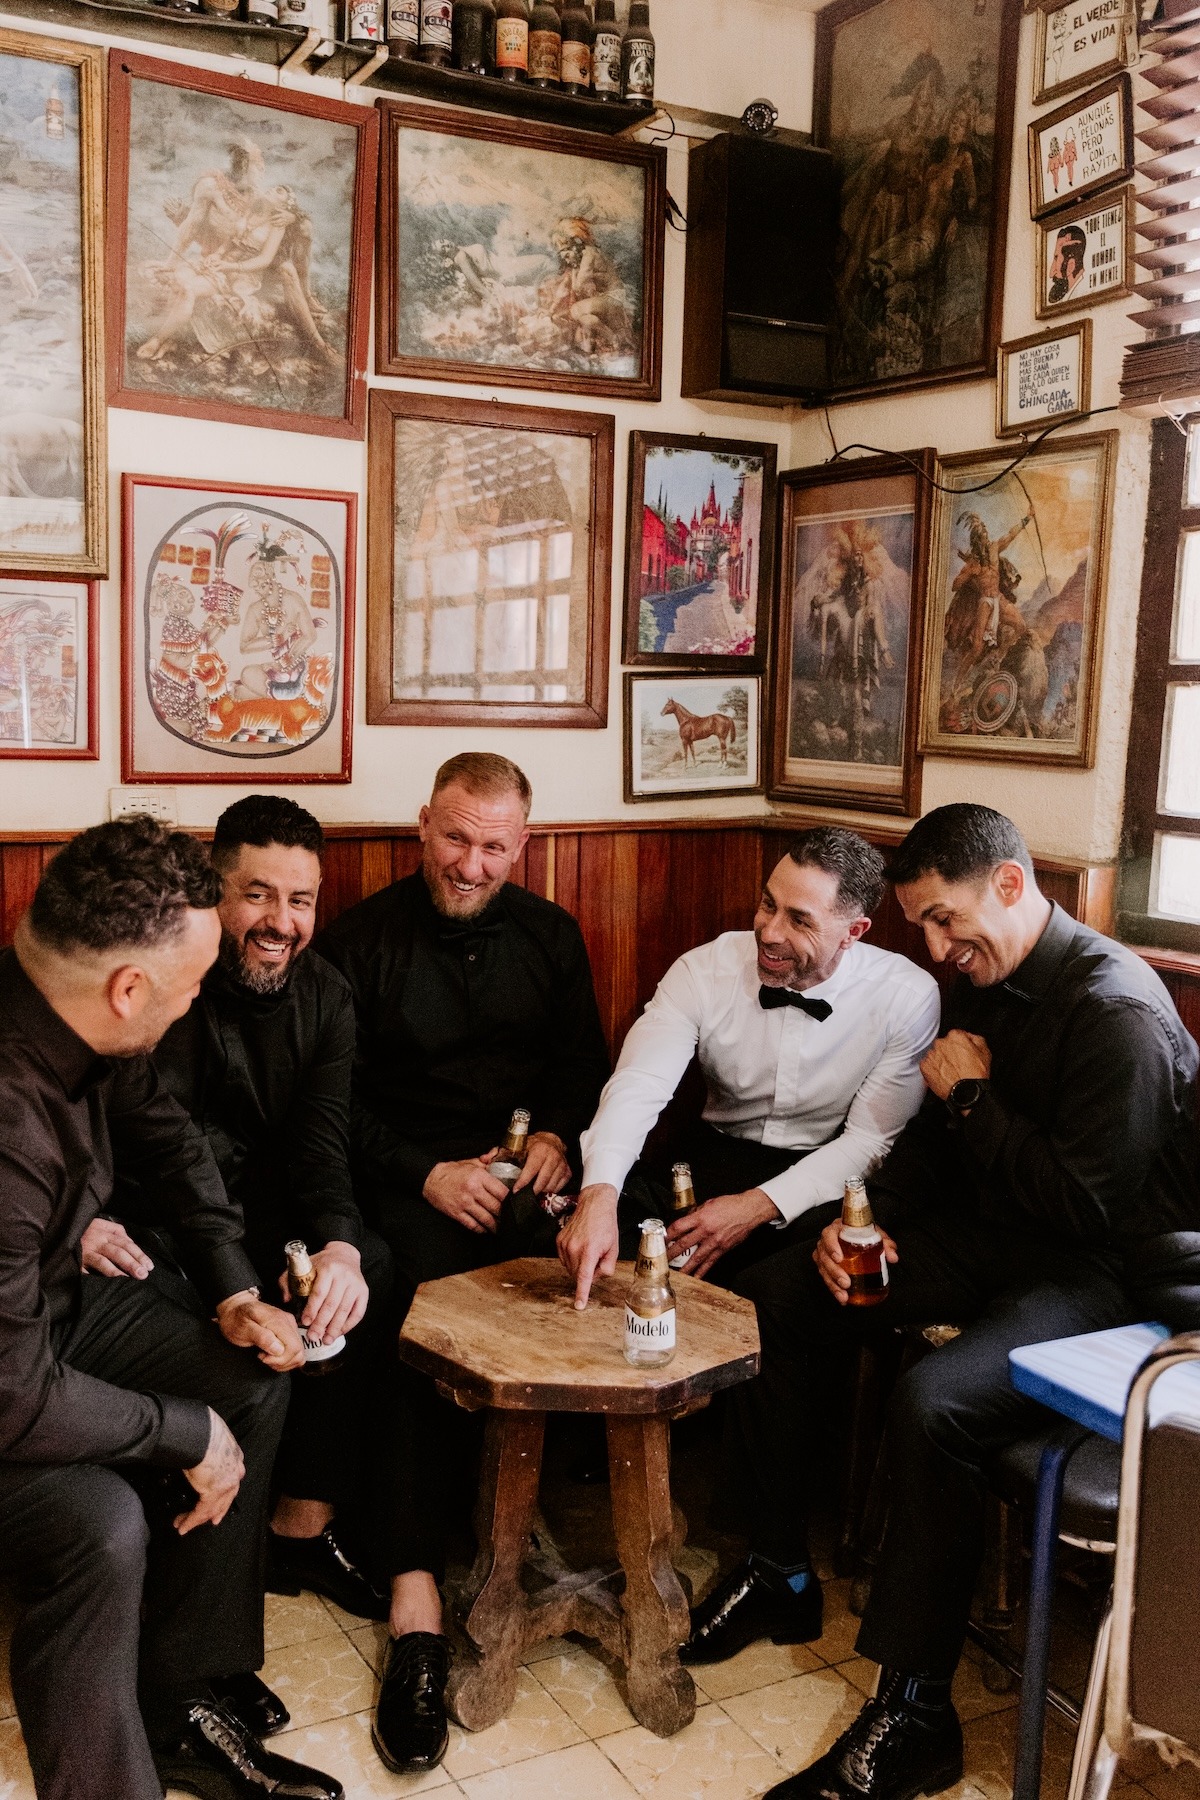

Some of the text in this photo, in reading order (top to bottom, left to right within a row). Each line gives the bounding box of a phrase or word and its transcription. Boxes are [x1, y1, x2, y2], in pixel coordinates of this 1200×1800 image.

[1074, 0, 1119, 30] EL VERDE
[1074, 24, 1116, 52] ES VIDA
[1078, 102, 1111, 128] AUNQUE
[1081, 114, 1114, 140] PELONAS
[1082, 133, 1103, 152] PERO
[1083, 153, 1118, 179] RAYITA
[1092, 246, 1116, 268] HOMBRE
[1019, 344, 1060, 361] NO HAY COSA
[1019, 359, 1032, 369] MAS
[1034, 353, 1054, 366] BUENA
[1019, 367, 1032, 376] MAS
[1019, 365, 1070, 384] QUE CADA QUIEN
[1019, 372, 1071, 391] HAGA LO QUE LE
[1019, 388, 1071, 409] CHINGADA
[1047, 398, 1076, 414] GANA
[626, 1314, 670, 1337] Modelo
